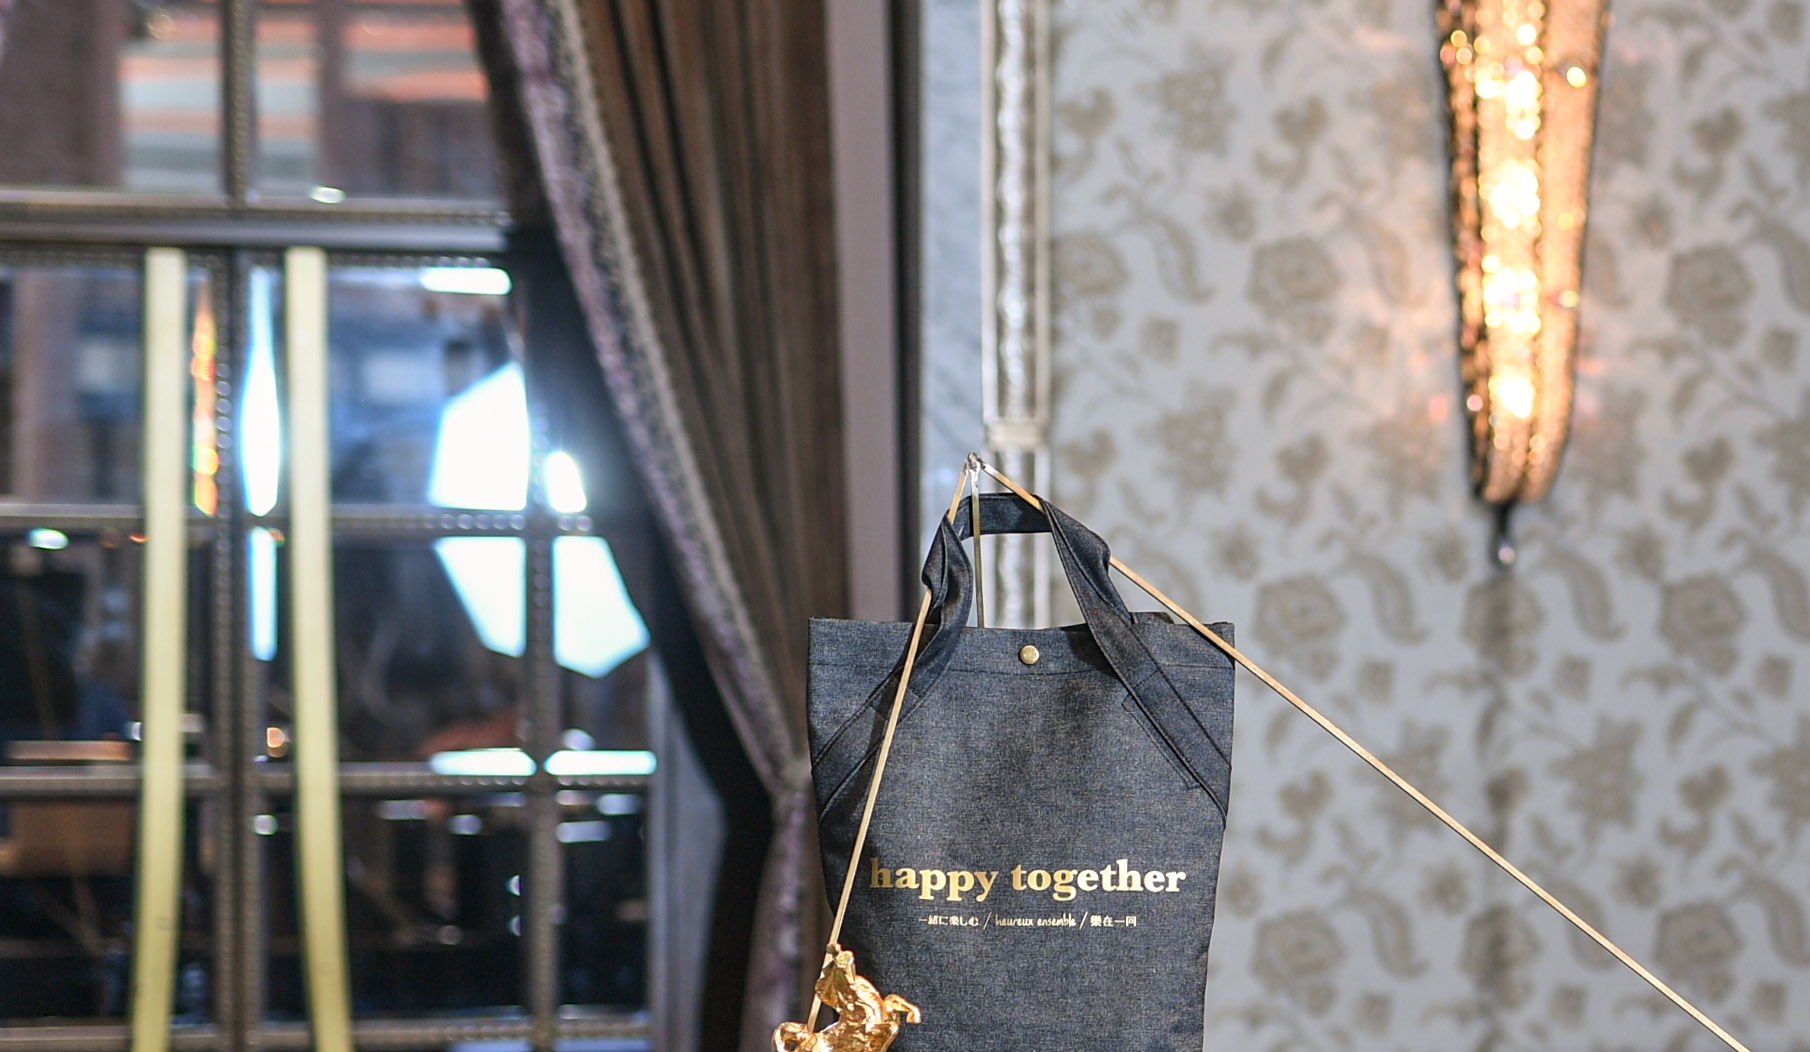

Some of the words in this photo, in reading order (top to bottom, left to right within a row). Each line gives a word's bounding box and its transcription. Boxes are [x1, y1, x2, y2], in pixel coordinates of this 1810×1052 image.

[869, 857, 999, 902] happy
[1011, 858, 1187, 901] together
[1037, 913, 1076, 927] ensemble
